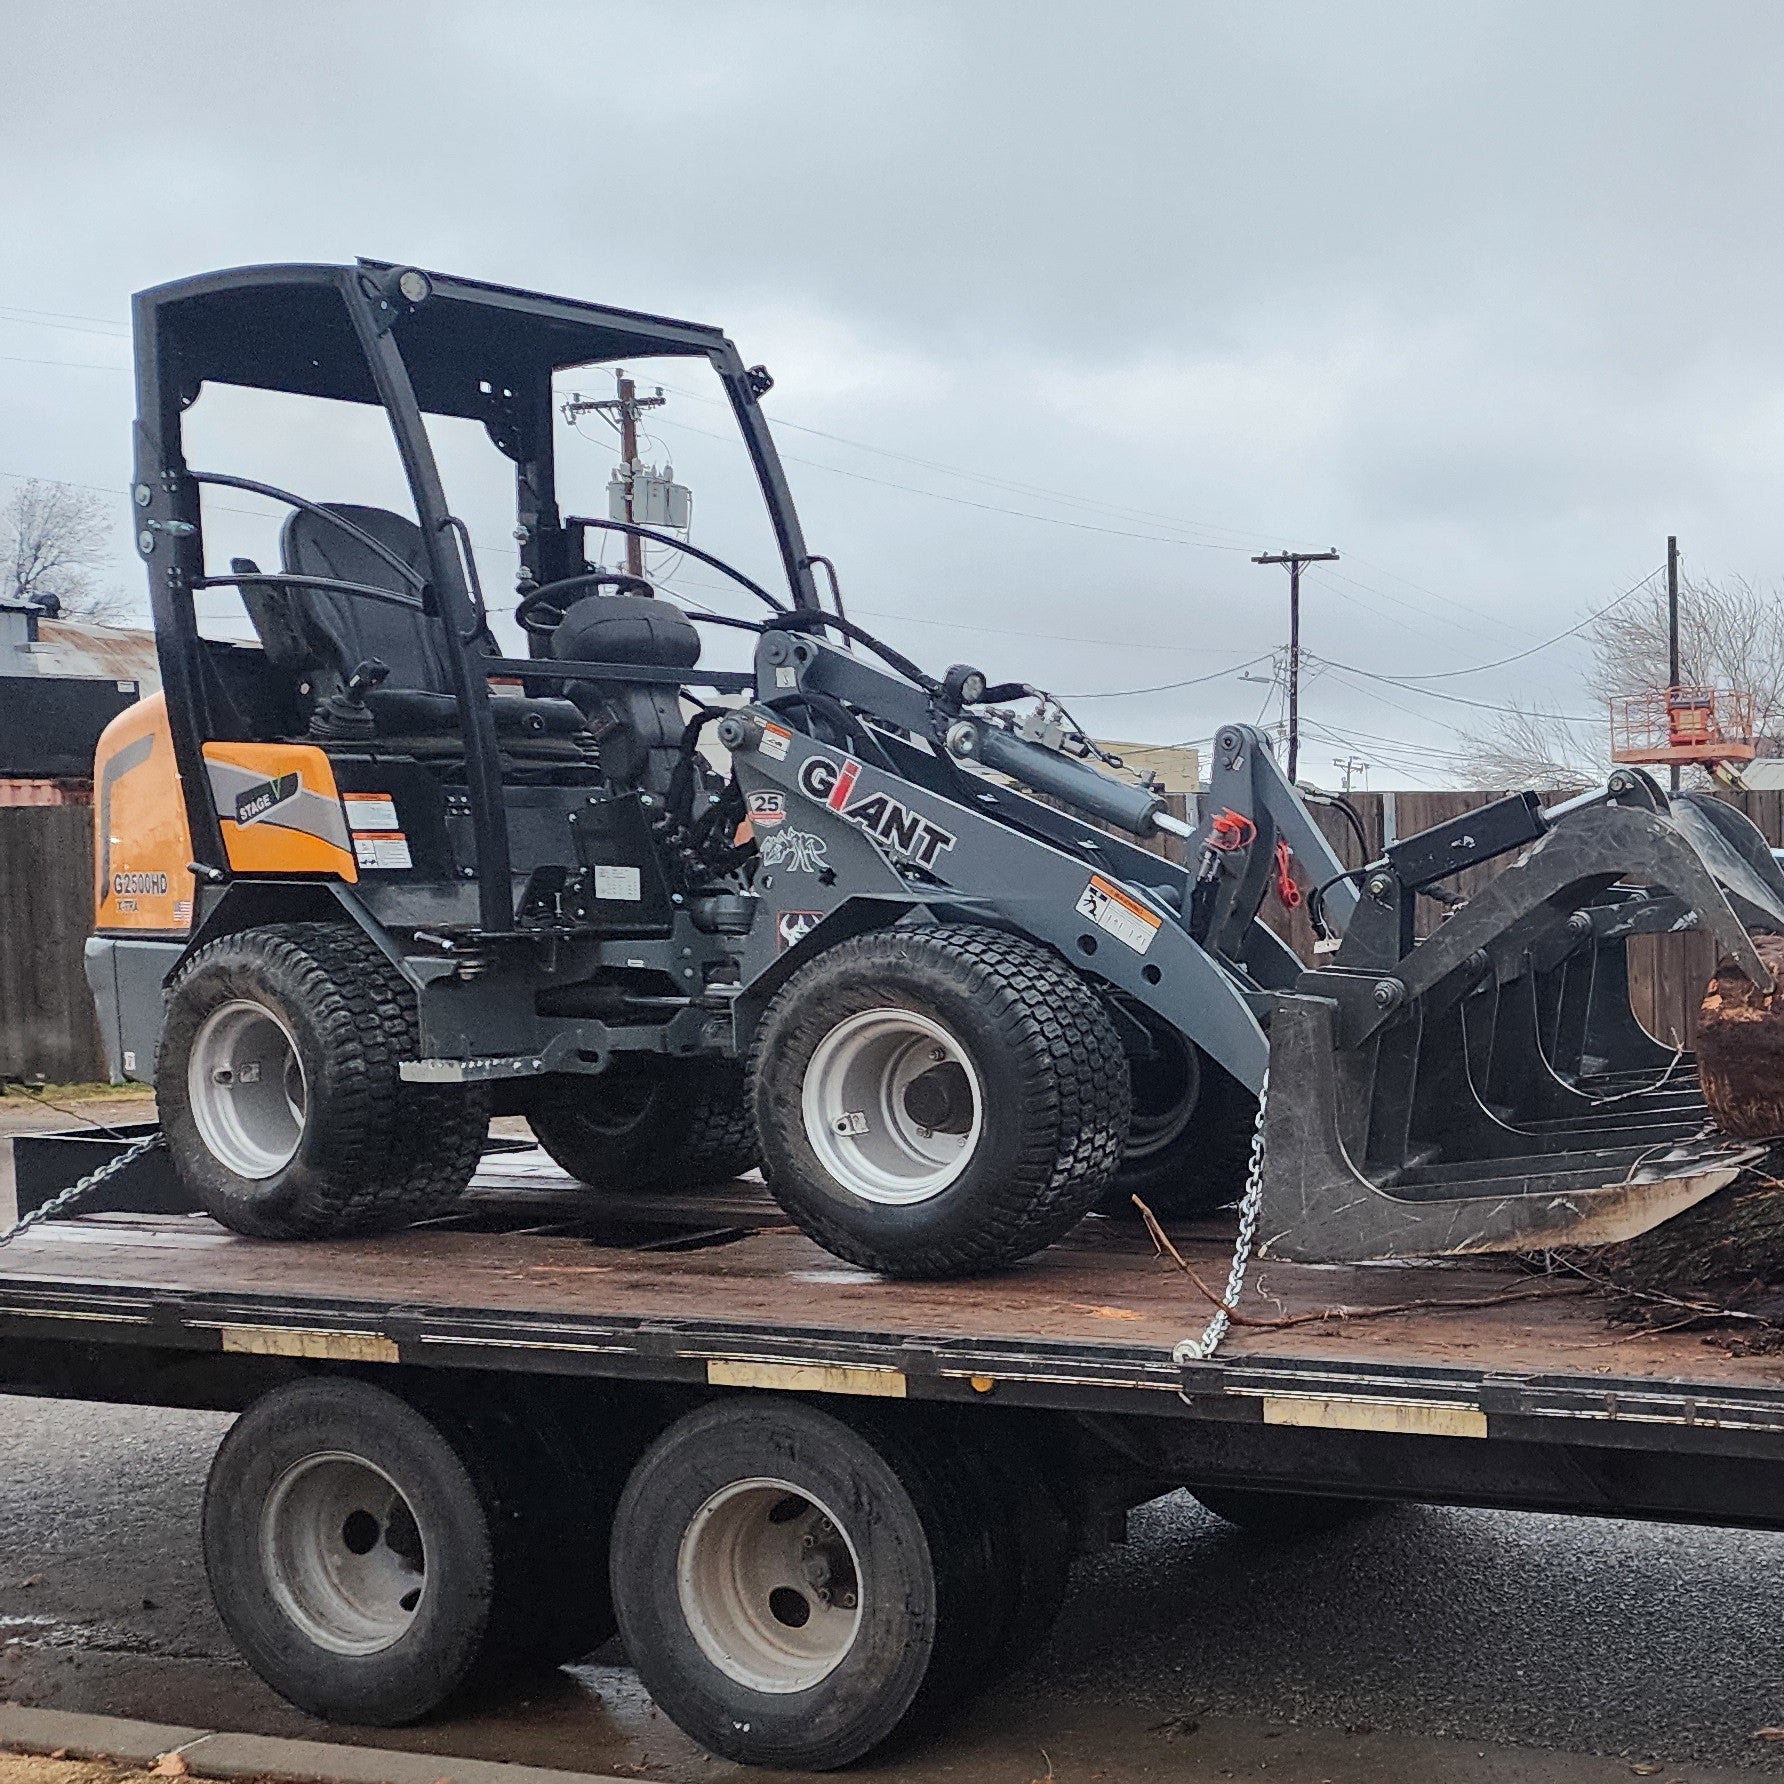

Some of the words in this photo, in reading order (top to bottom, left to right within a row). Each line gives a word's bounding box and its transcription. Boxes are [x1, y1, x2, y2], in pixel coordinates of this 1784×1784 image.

[240, 794, 272, 820] STAGE
[755, 796, 779, 812] 25
[113, 872, 168, 895] G2500HD
